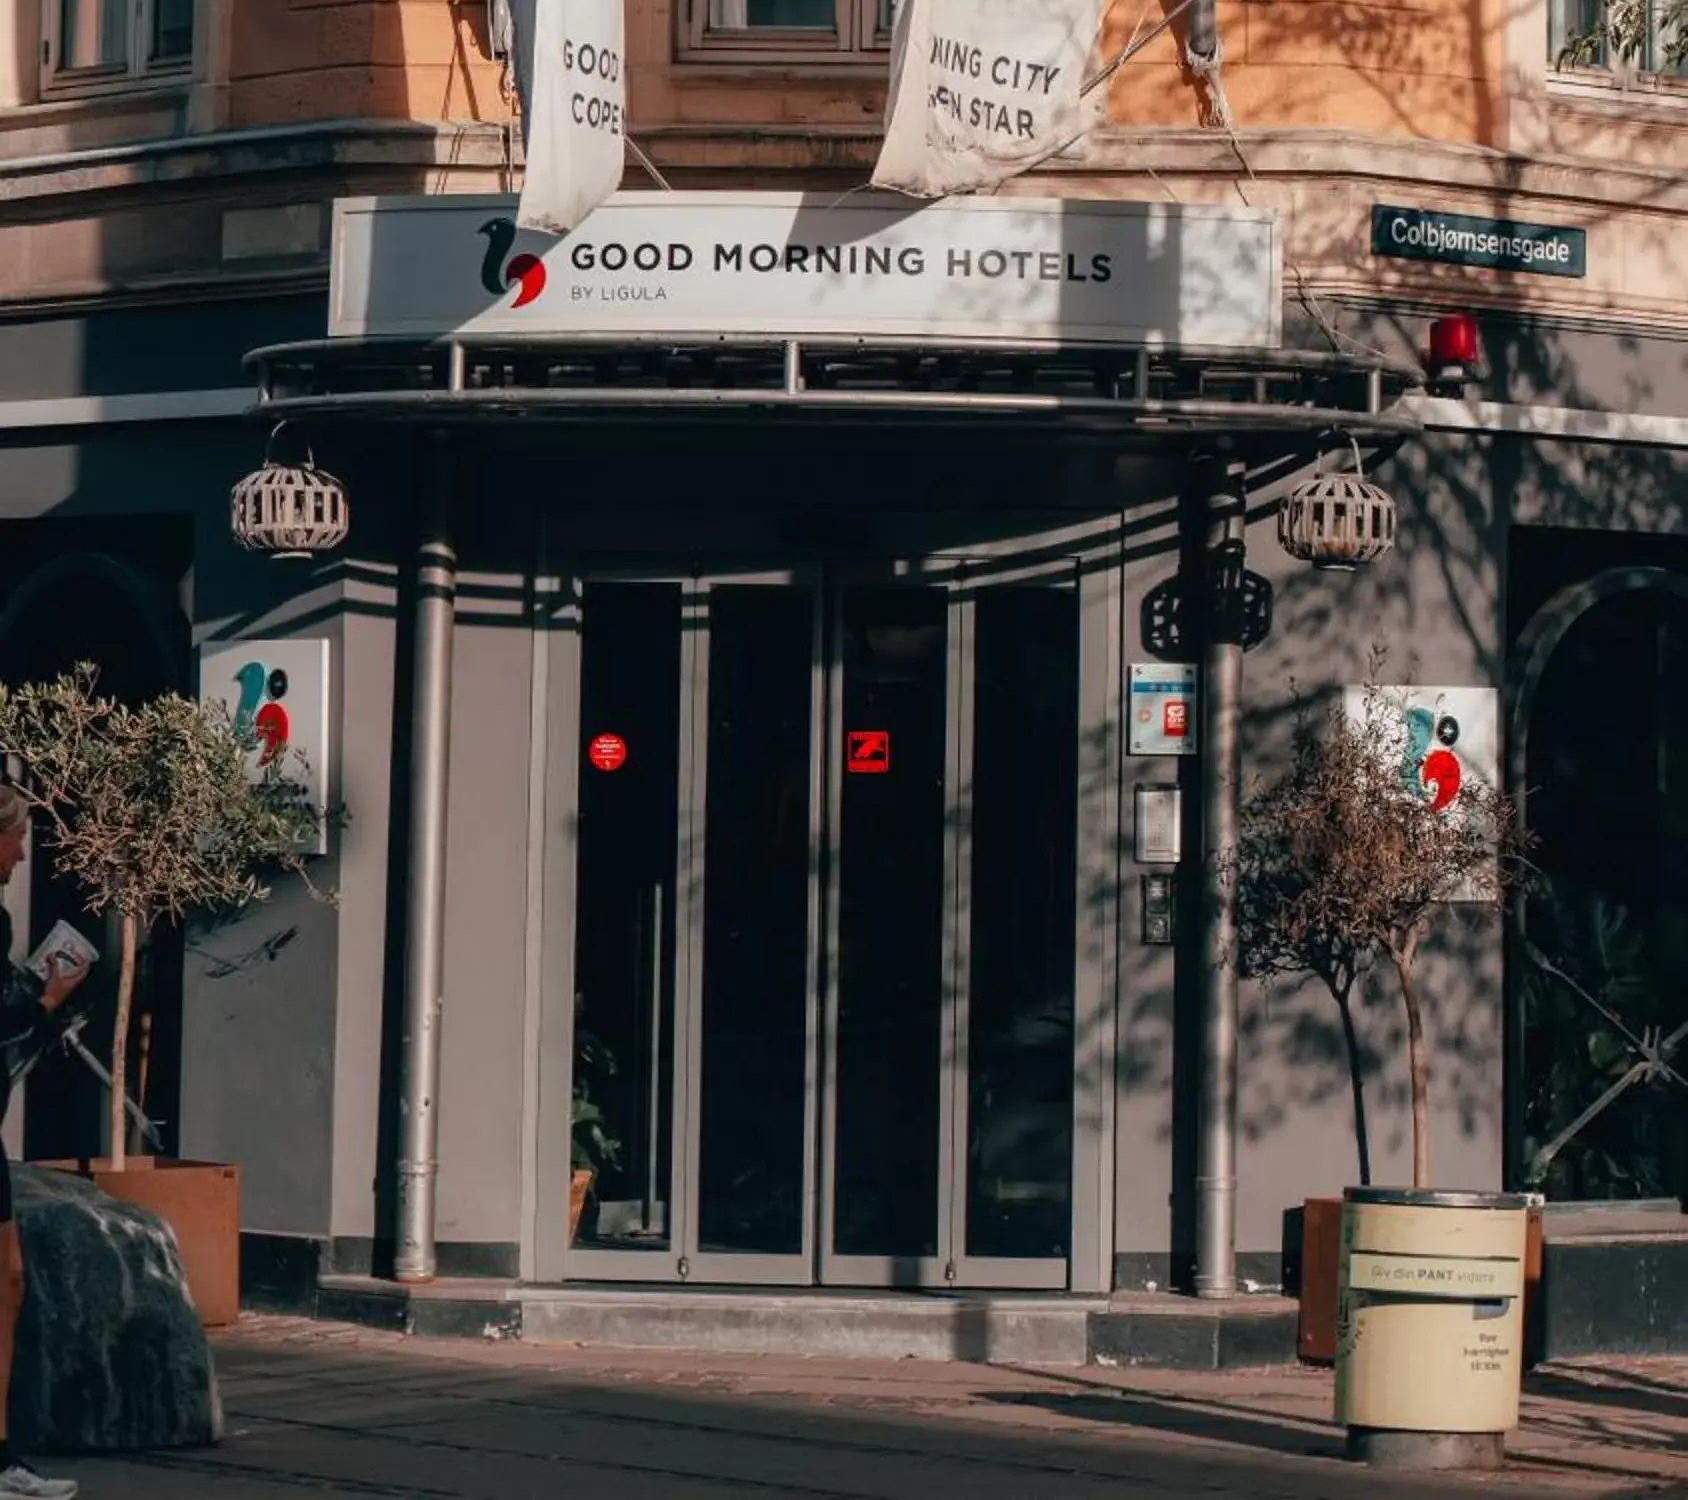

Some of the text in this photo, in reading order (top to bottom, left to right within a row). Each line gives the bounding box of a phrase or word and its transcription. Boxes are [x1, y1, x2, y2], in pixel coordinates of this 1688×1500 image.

[563, 38, 619, 82] GOOD
[992, 55, 1061, 95] CITY
[572, 92, 625, 135] COPE
[969, 97, 1034, 140] STAR
[1391, 217, 1570, 263] Colbjørnsensgade
[571, 243, 1111, 282] GOOD MORNING HOTELS
[571, 286, 667, 301] BY LIGULA
[1417, 1269, 1455, 1281] PANT
